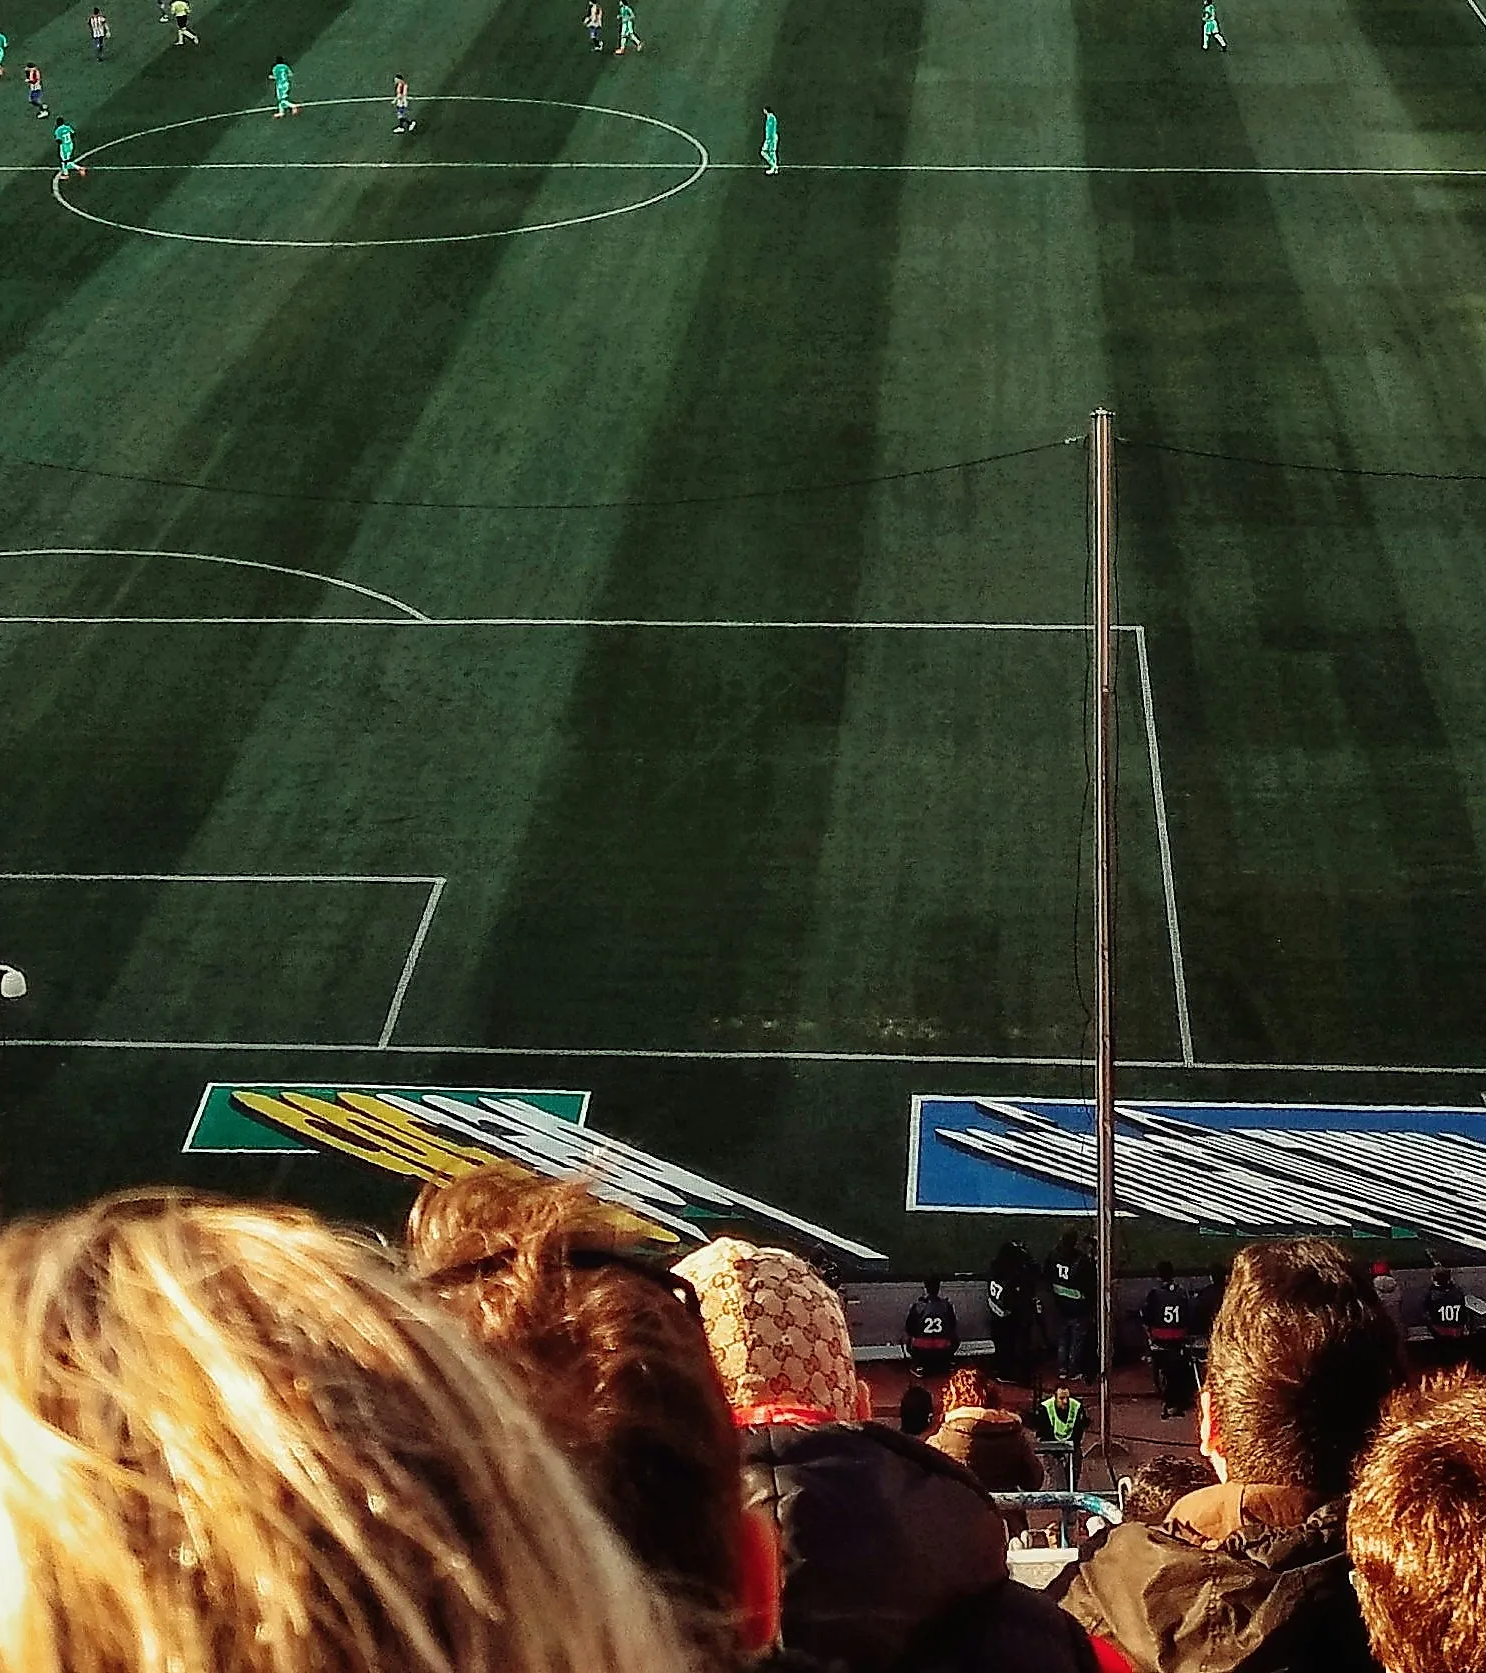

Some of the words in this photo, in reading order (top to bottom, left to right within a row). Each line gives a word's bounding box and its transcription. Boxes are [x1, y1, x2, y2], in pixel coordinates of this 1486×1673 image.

[989, 1280, 1004, 1300] 67
[1163, 1305, 1180, 1324] 51
[1437, 1305, 1462, 1323] 107
[923, 1317, 943, 1334] 23
